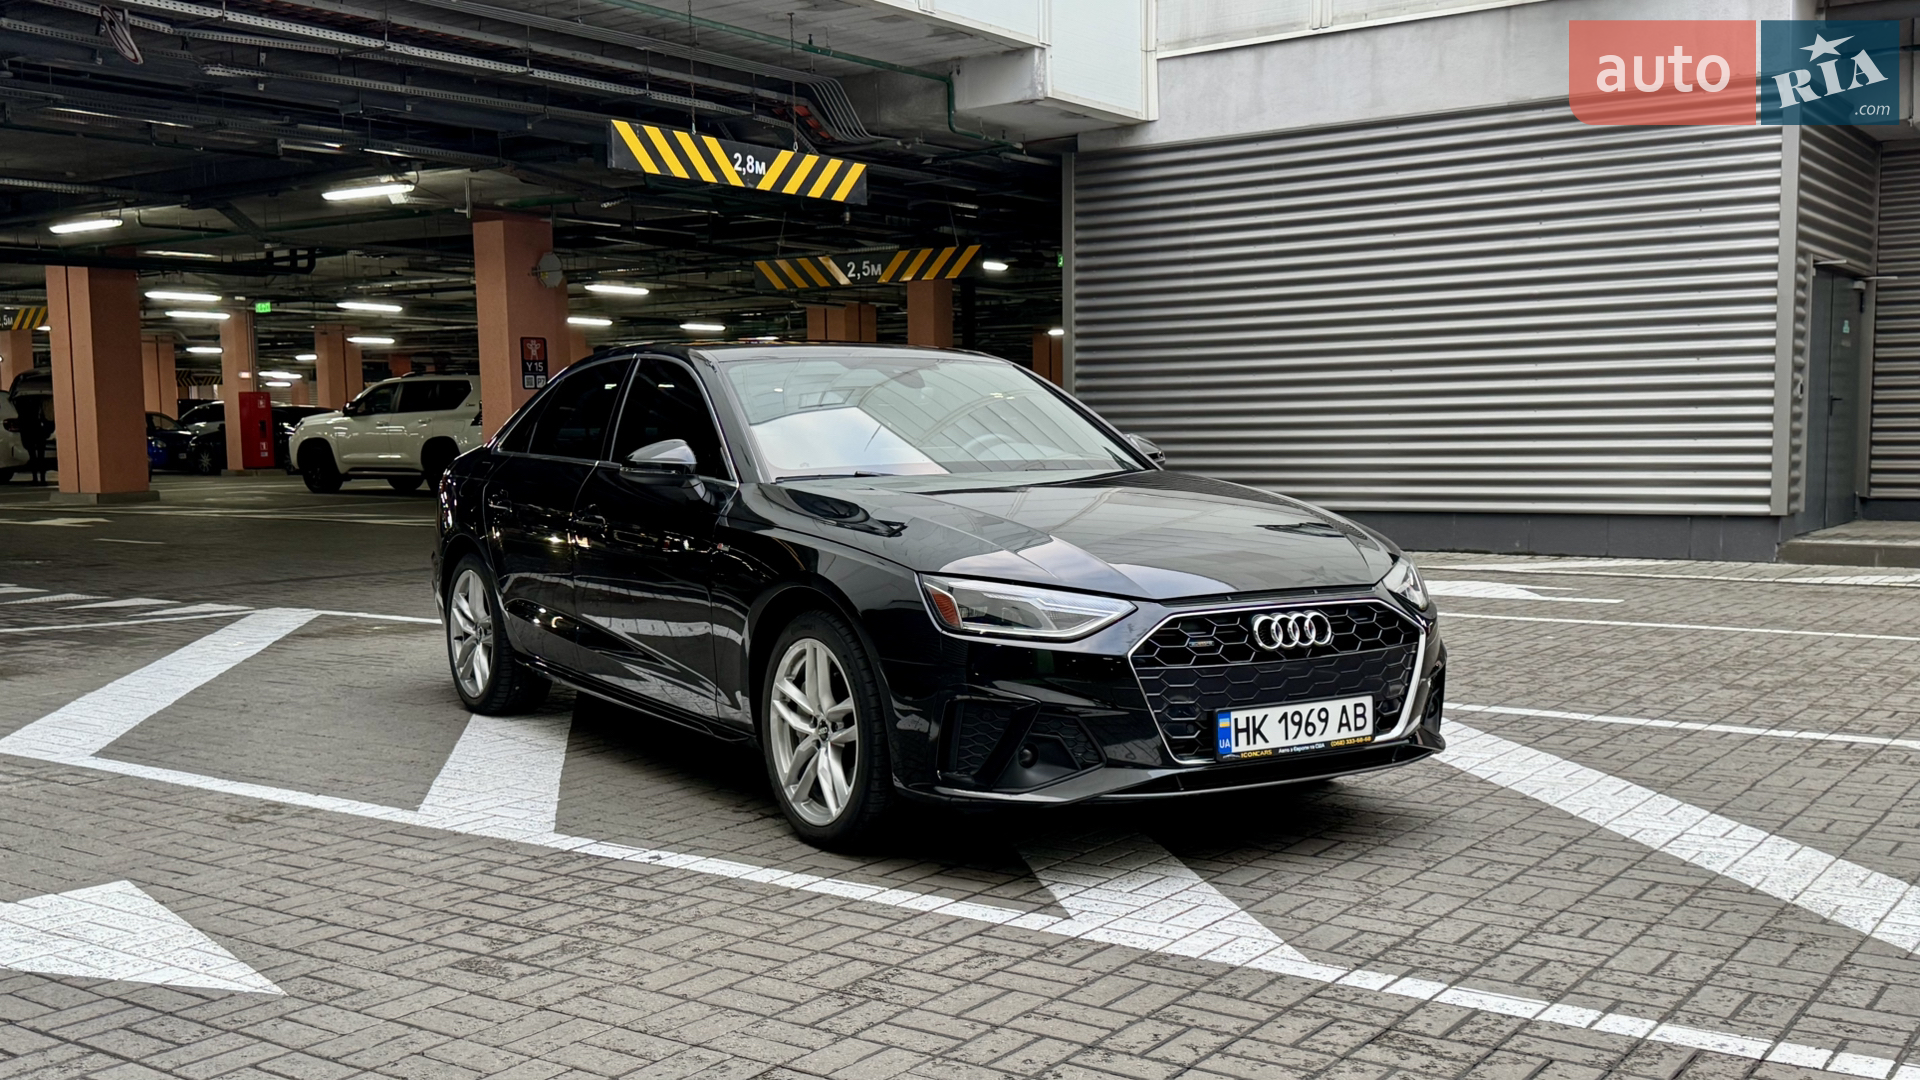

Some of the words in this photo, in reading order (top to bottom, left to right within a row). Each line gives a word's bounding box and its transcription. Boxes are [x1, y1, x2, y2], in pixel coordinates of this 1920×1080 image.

[526, 362, 532, 371] Y
[534, 362, 544, 372] 15
[1234, 714, 1269, 748] HK
[1278, 707, 1329, 741] 1969
[1337, 702, 1367, 734] AB
[1219, 738, 1231, 749] UA
[1240, 749, 1273, 758] ICONCARS
